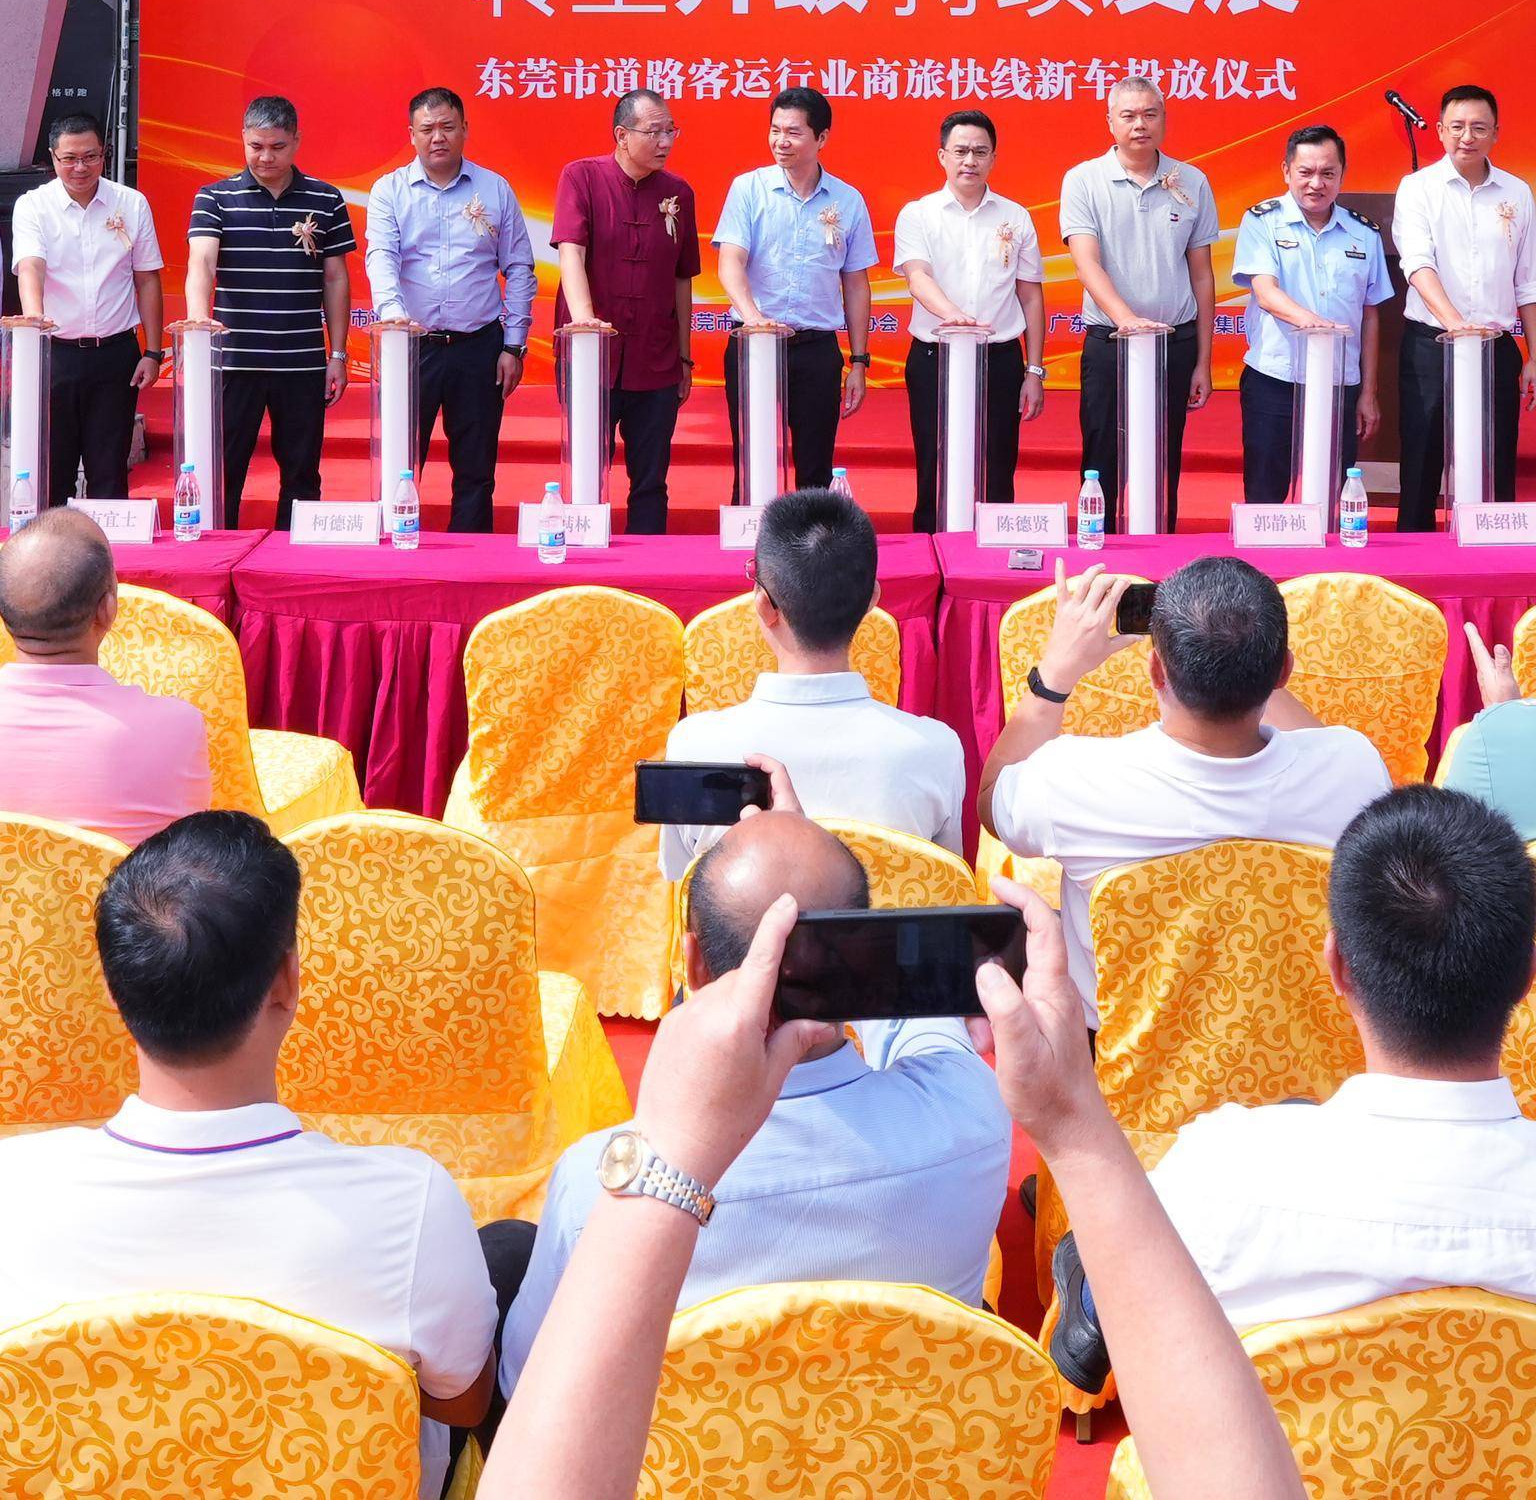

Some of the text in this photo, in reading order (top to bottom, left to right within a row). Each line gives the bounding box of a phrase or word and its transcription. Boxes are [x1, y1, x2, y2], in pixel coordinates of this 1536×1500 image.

[312, 513, 365, 532] 柯德满
[996, 514, 1050, 534] 陈德贤
